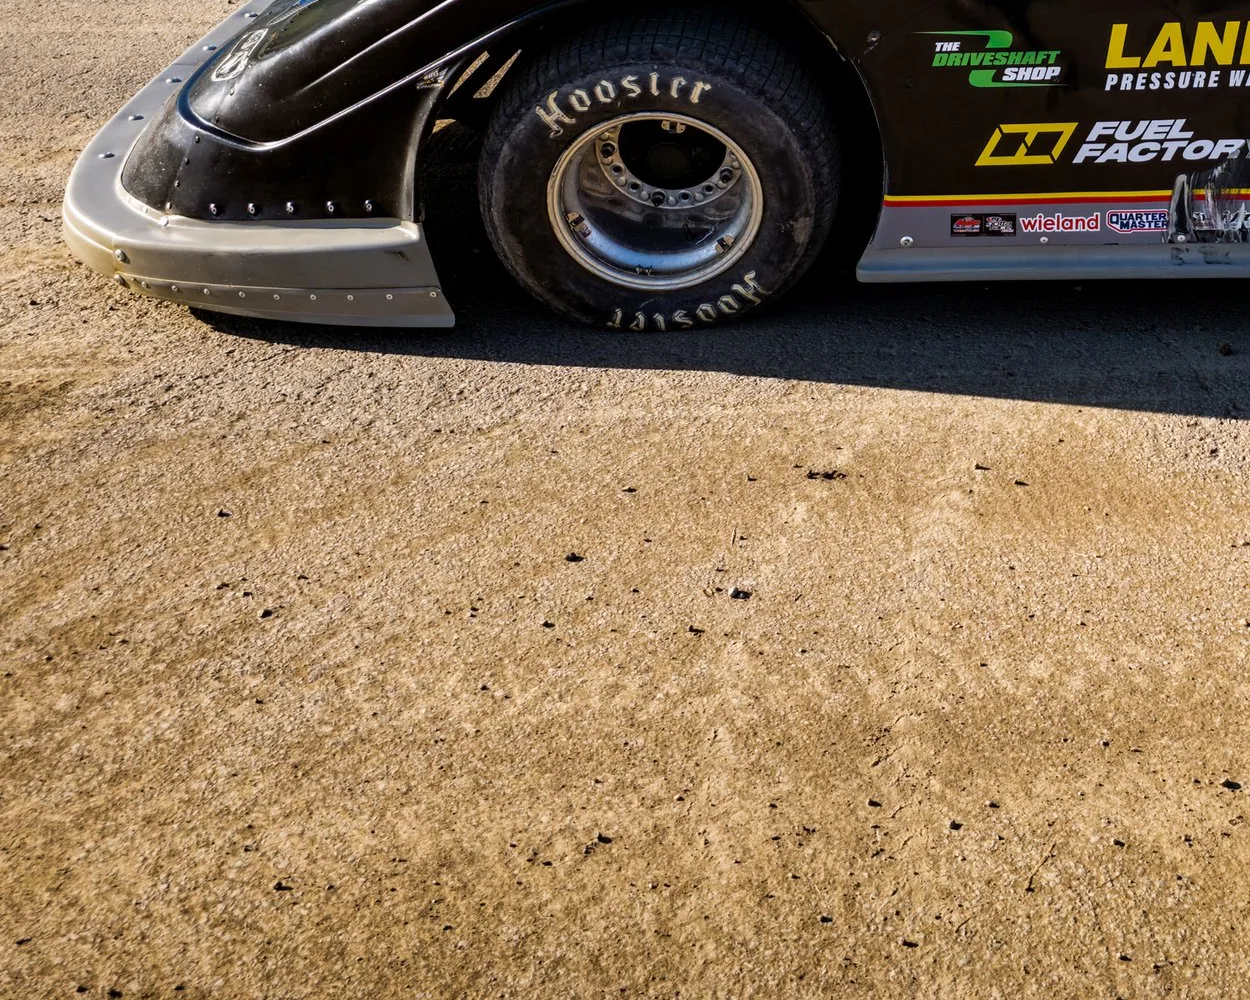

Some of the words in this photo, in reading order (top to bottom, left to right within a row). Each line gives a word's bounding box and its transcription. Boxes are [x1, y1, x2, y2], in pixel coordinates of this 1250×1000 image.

[935, 41, 961, 52] THE
[932, 50, 1061, 67] DRIVESHAFT
[1002, 66, 1061, 81] SHOP
[1104, 70, 1221, 91] PRESSURE
[535, 67, 712, 139] Hoosier
[1086, 118, 1196, 142] FUEL
[1020, 212, 1100, 233] wieland
[1119, 220, 1168, 230] MASTER
